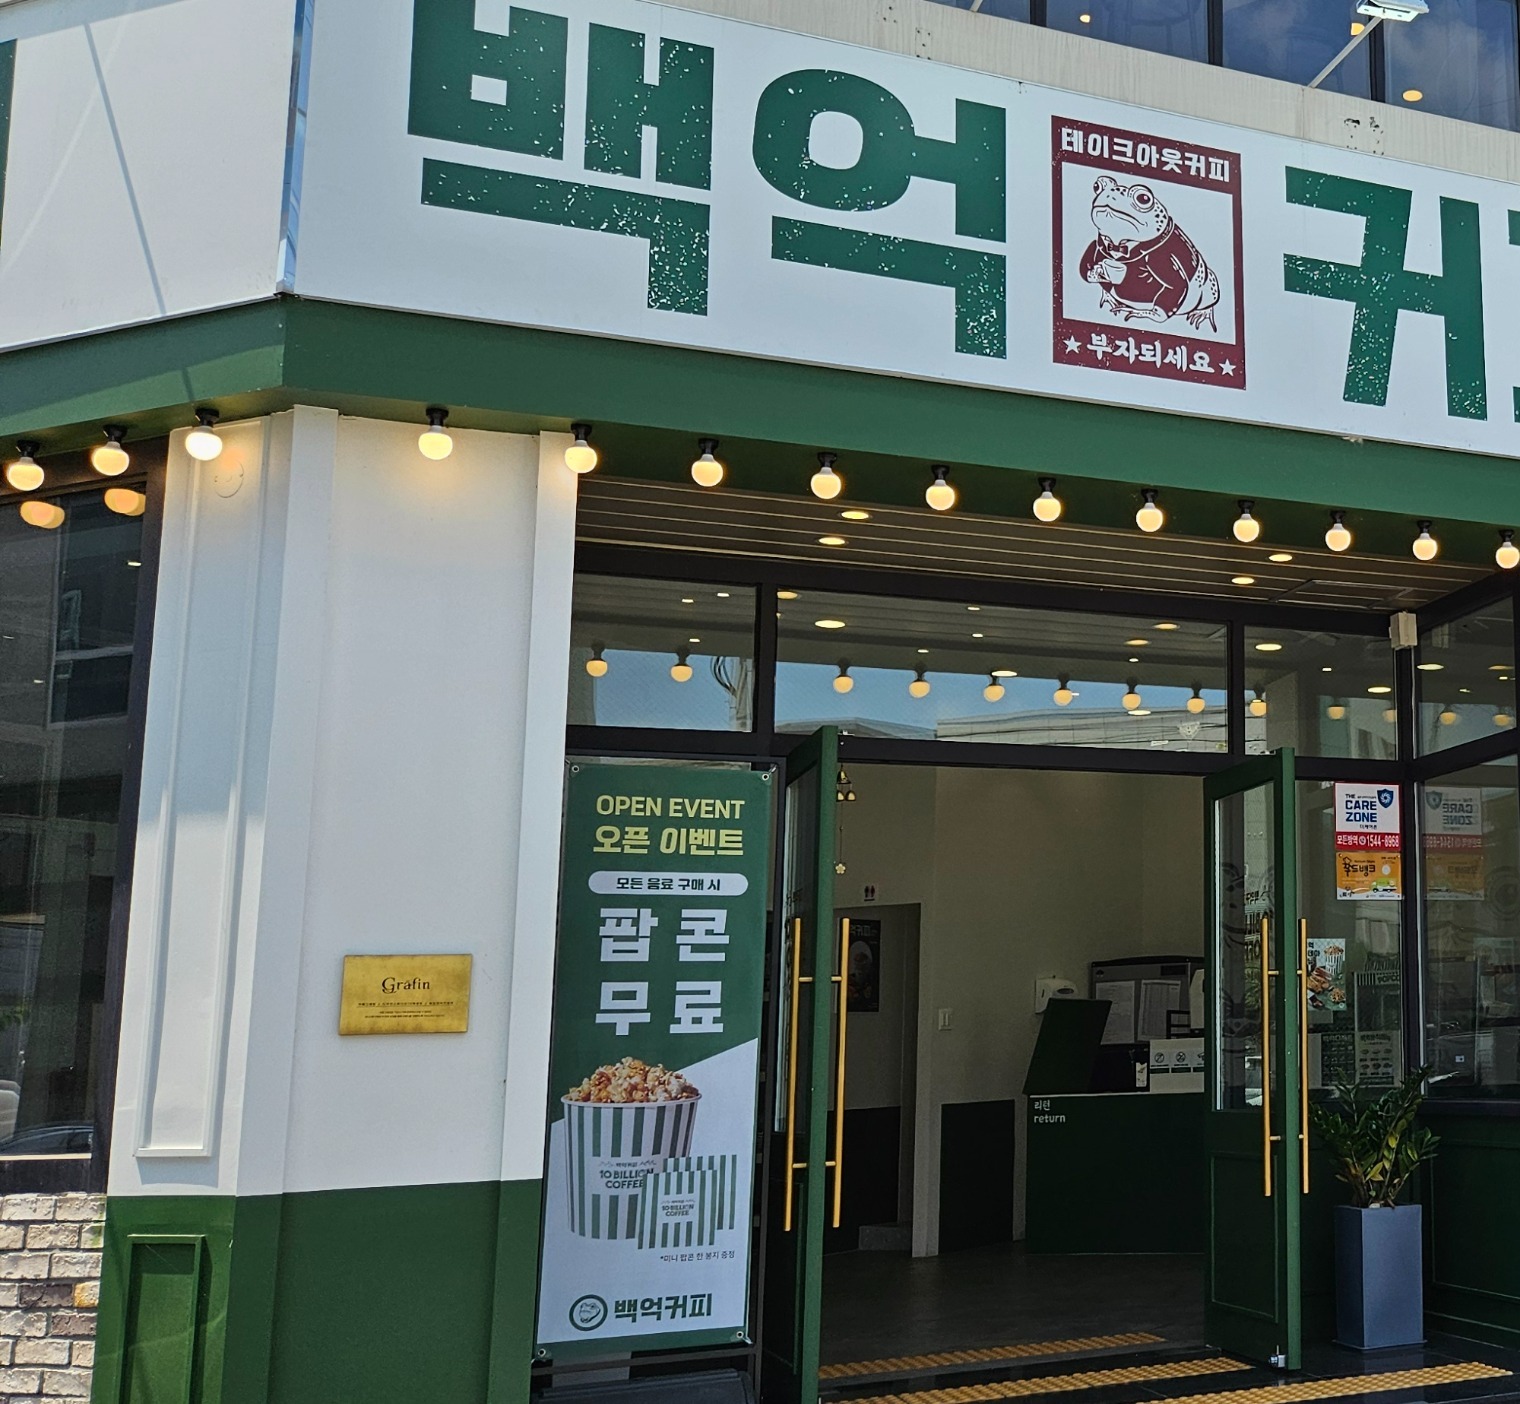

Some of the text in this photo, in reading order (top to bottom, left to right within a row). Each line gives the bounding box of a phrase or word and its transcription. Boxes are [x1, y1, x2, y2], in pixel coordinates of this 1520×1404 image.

[1060, 126, 1231, 183] 테이크아웃커피
[407, 0, 1007, 360] 백억
[1086, 332, 1216, 374] 부자되세요
[596, 794, 745, 820] OPEN EVENT
[1345, 800, 1377, 811] CARE
[1345, 811, 1377, 823] ZONE
[593, 825, 744, 856] 오픈 이벤트
[616, 877, 721, 891] 모든 음료 구매 시
[1033, 1099, 1051, 1111] 리턴
[1033, 1113, 1066, 1124] return
[599, 1169, 612, 1179] 10
[605, 1179, 644, 1189] COFFEE
[680, 1253, 694, 1262] 팝콘
[696, 1253, 704, 1261] 한
[721, 1250, 735, 1259] 증정
[614, 1292, 713, 1323] 백억커피
